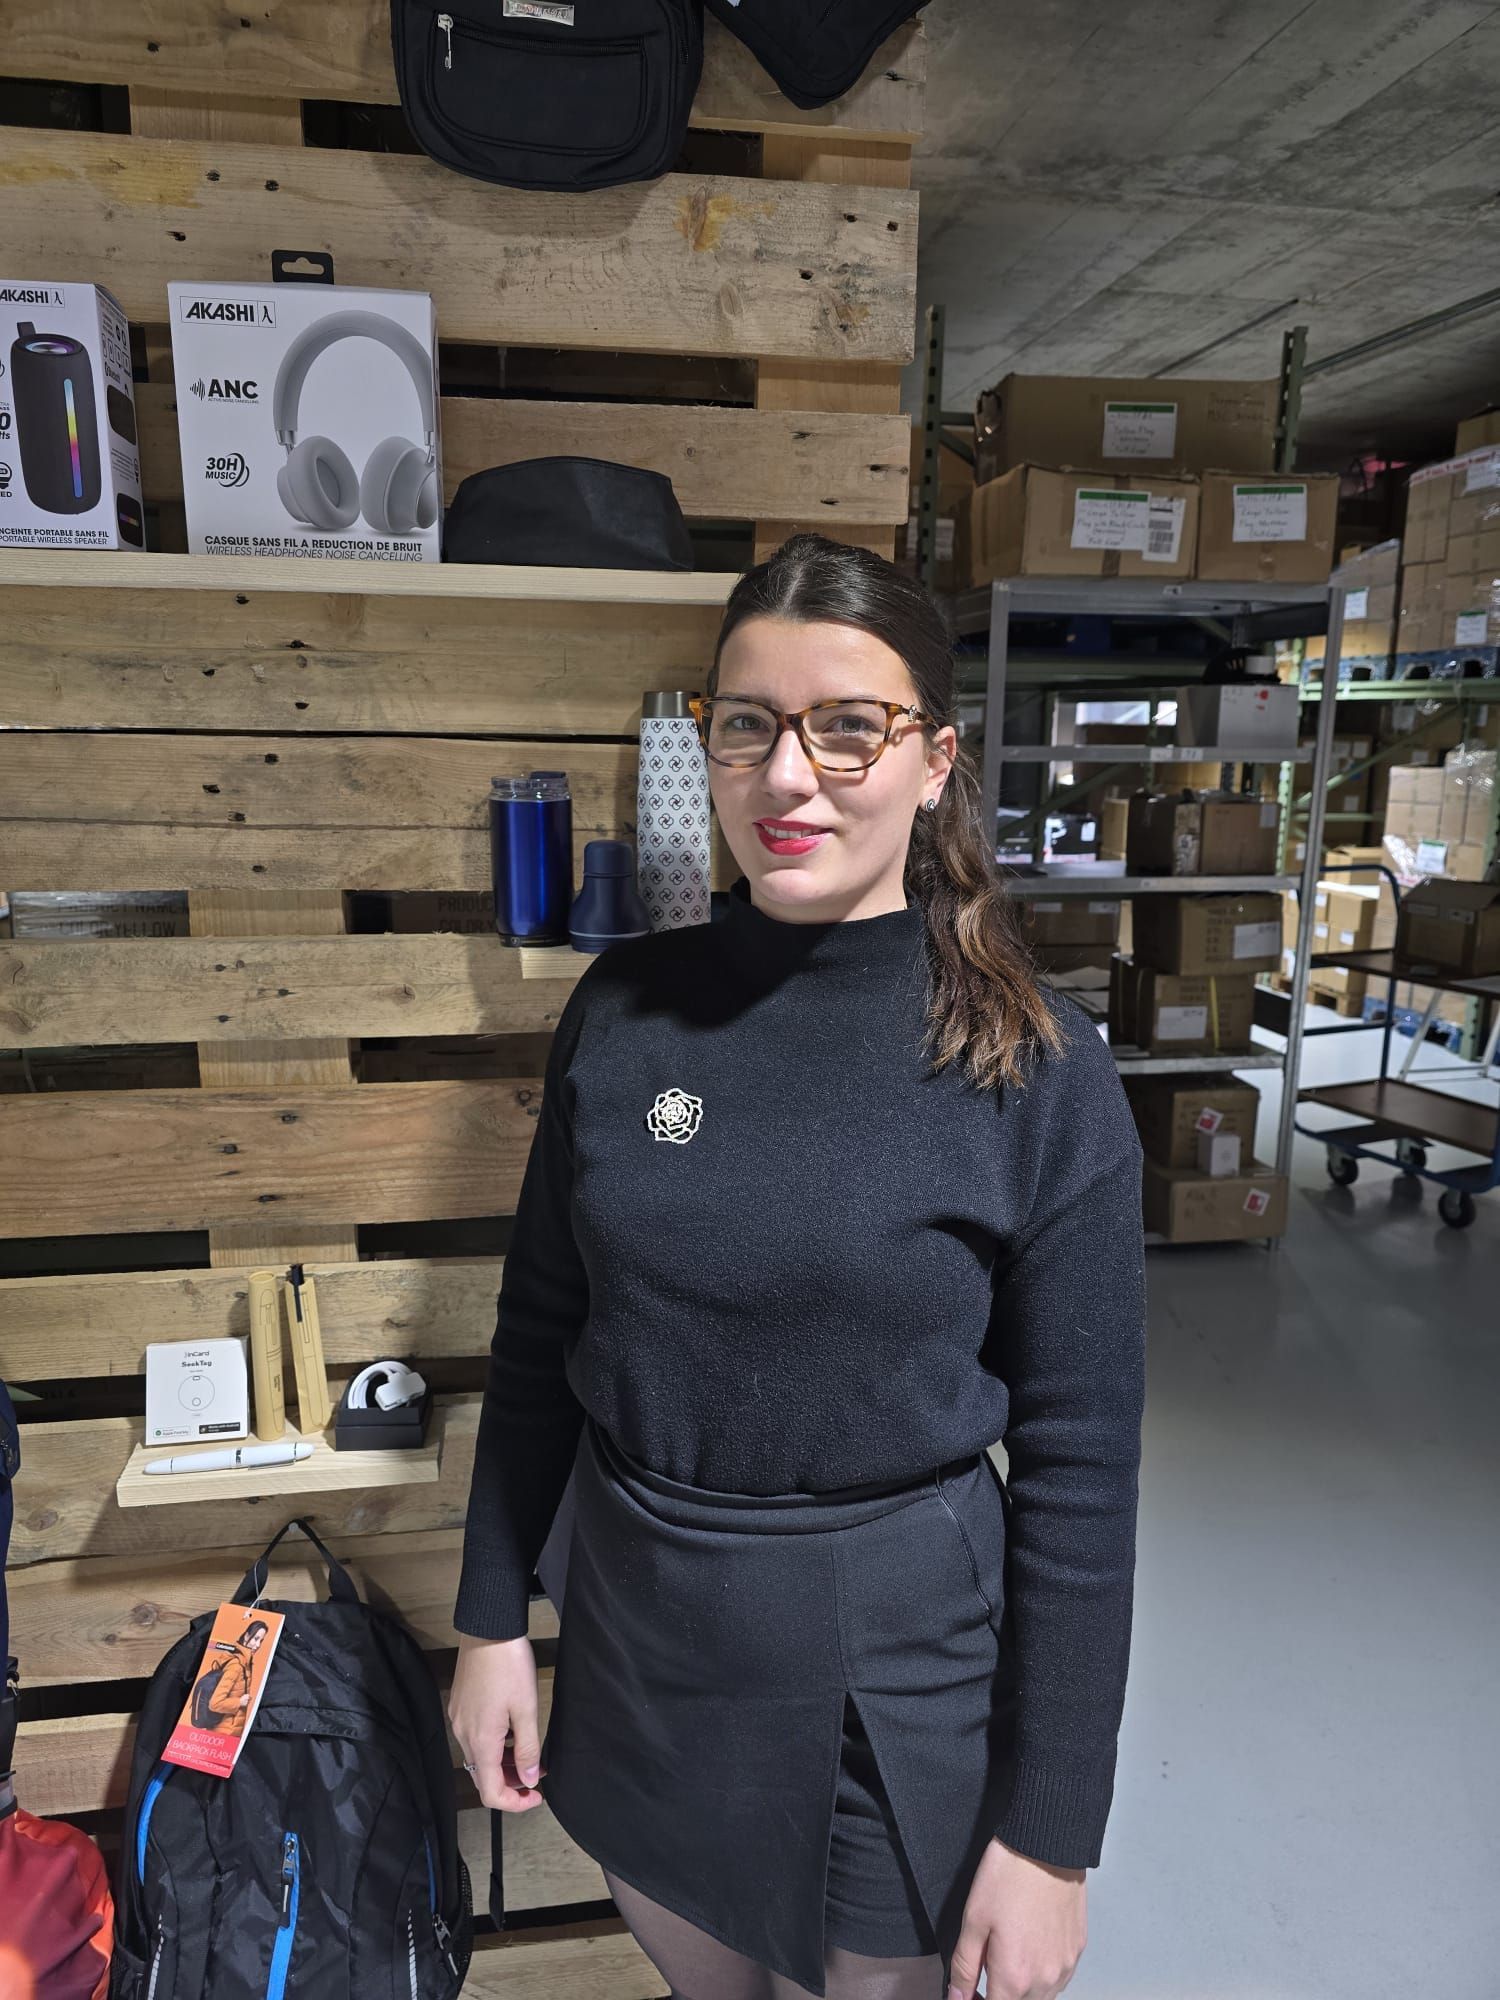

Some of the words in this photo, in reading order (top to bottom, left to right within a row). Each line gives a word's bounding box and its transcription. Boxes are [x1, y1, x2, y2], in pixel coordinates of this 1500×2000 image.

[0, 289, 49, 303] AKASHI
[185, 302, 255, 322] AKASHI
[208, 378, 259, 399] ANC
[206, 457, 238, 471] 30H
[205, 471, 237, 480] MUSIC
[34, 529, 73, 537] PORTABLE
[75, 530, 97, 538] SANS
[37, 536, 73, 544] WIRELESS
[74, 537, 107, 545] SPEAKER
[204, 535, 250, 546] CASQUE
[252, 537, 281, 547] SANS
[284, 538, 298, 548] FIL
[312, 539, 373, 550] REDUCTION
[376, 541, 390, 551] DE
[393, 542, 422, 552] BRUIT
[206, 545, 252, 556] WIRELESS
[254, 547, 323, 559] HEADPHONES
[325, 549, 356, 560] NOISE
[358, 550, 423, 562] CANCELLING
[190, 1731, 225, 1747] OUTDOOR
[173, 1739, 210, 1755] BACKPACK
[209, 1748, 232, 1761] FLASH
